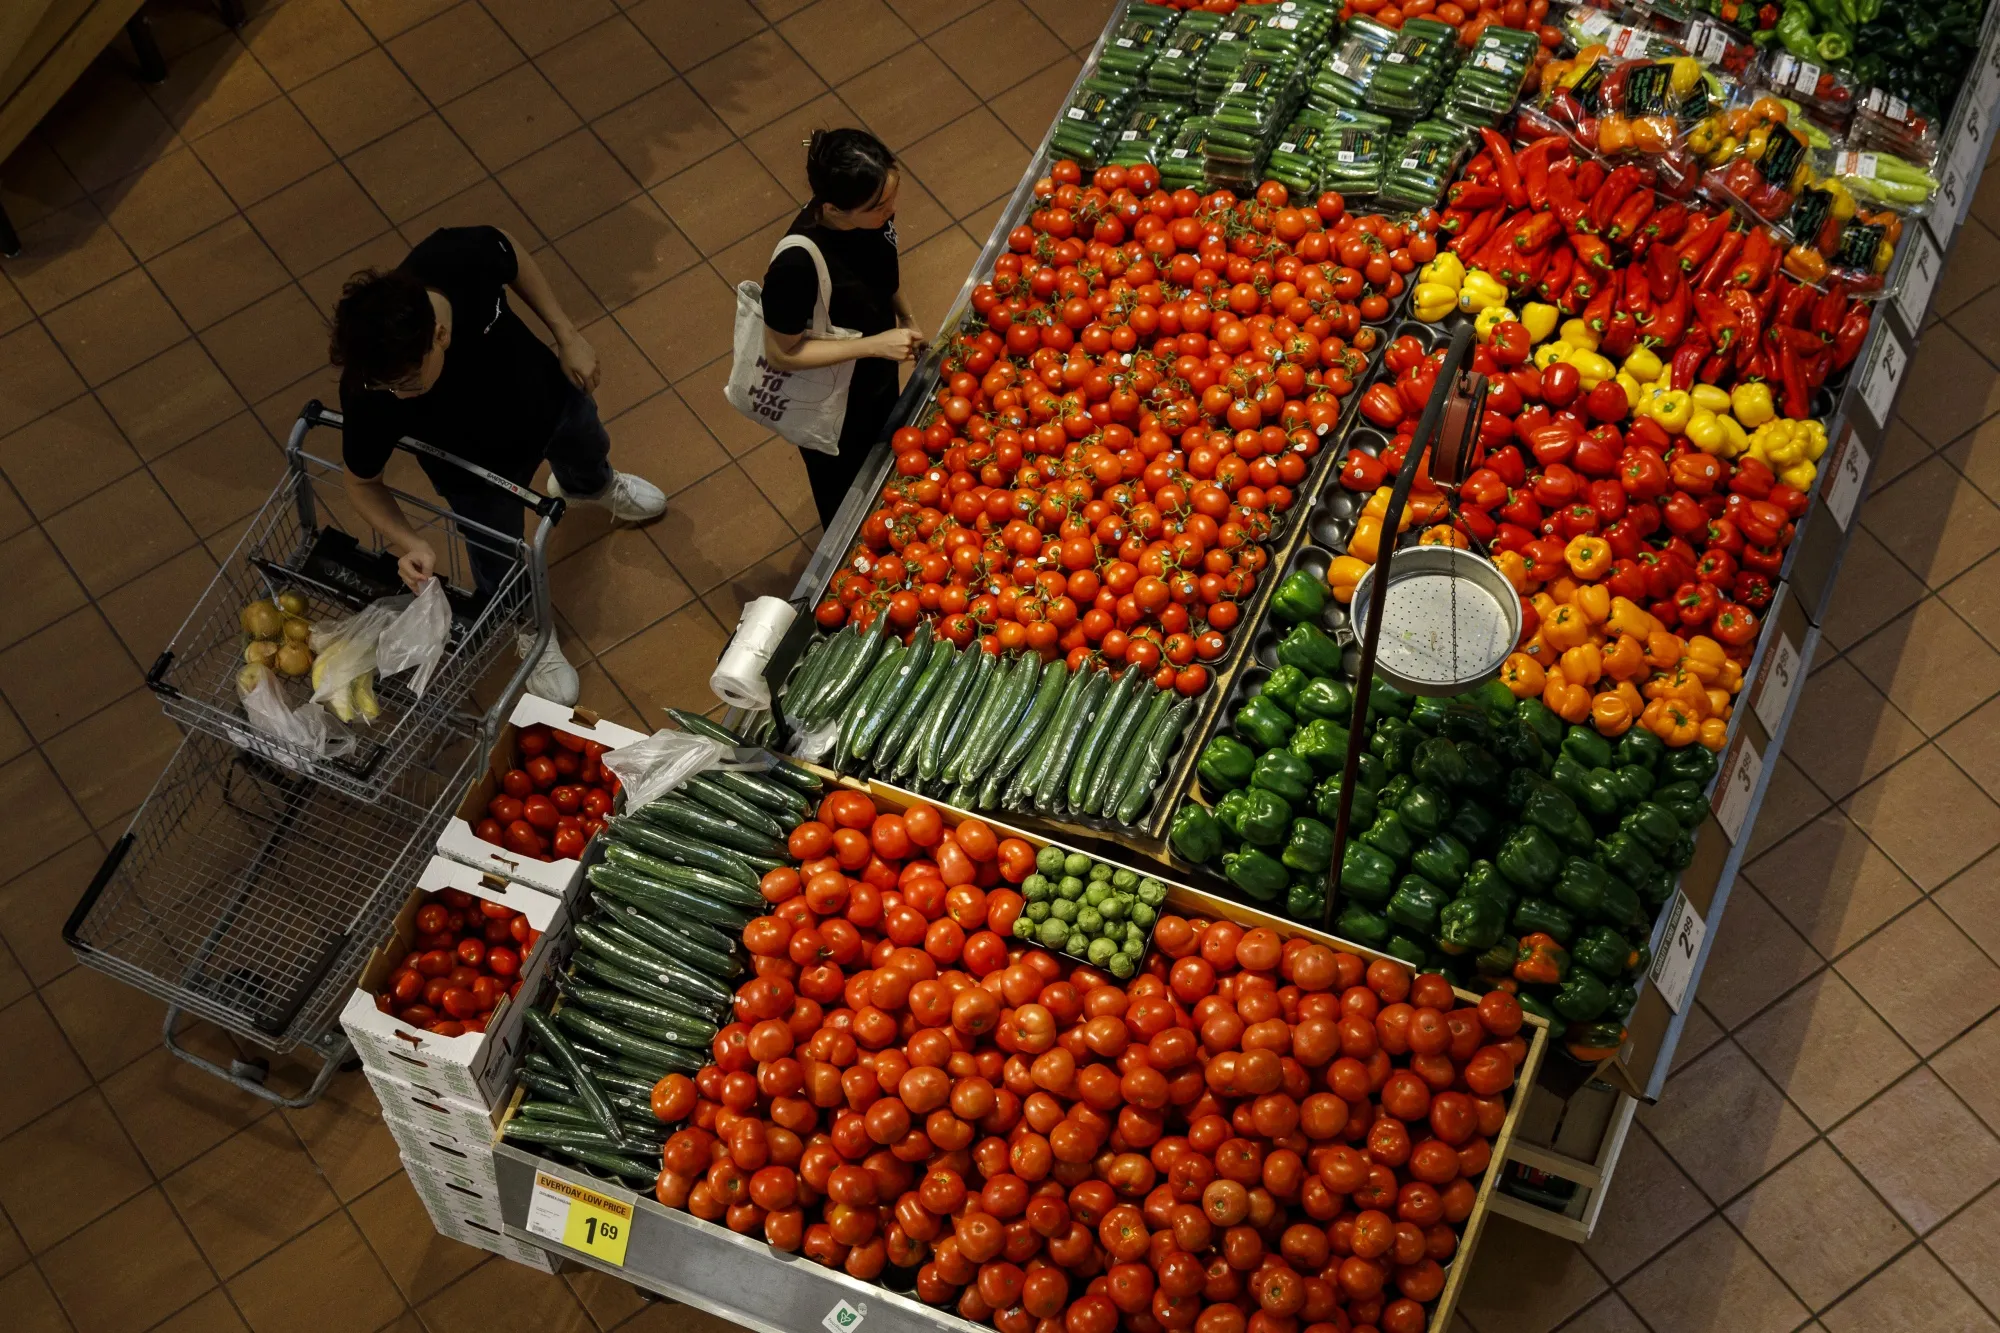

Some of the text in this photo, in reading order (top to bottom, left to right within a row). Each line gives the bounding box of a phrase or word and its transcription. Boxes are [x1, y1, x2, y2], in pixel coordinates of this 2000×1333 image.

[762, 374, 784, 392] TO
[753, 401, 783, 422] YOU
[486, 472, 513, 490] Loblaws
[1655, 944, 1670, 975] QUALITY
[1665, 929, 1675, 943] YOU
[540, 1176, 581, 1198] EVERYDAY
[583, 1192, 602, 1207] LOW
[603, 1201, 627, 1216] PRICE
